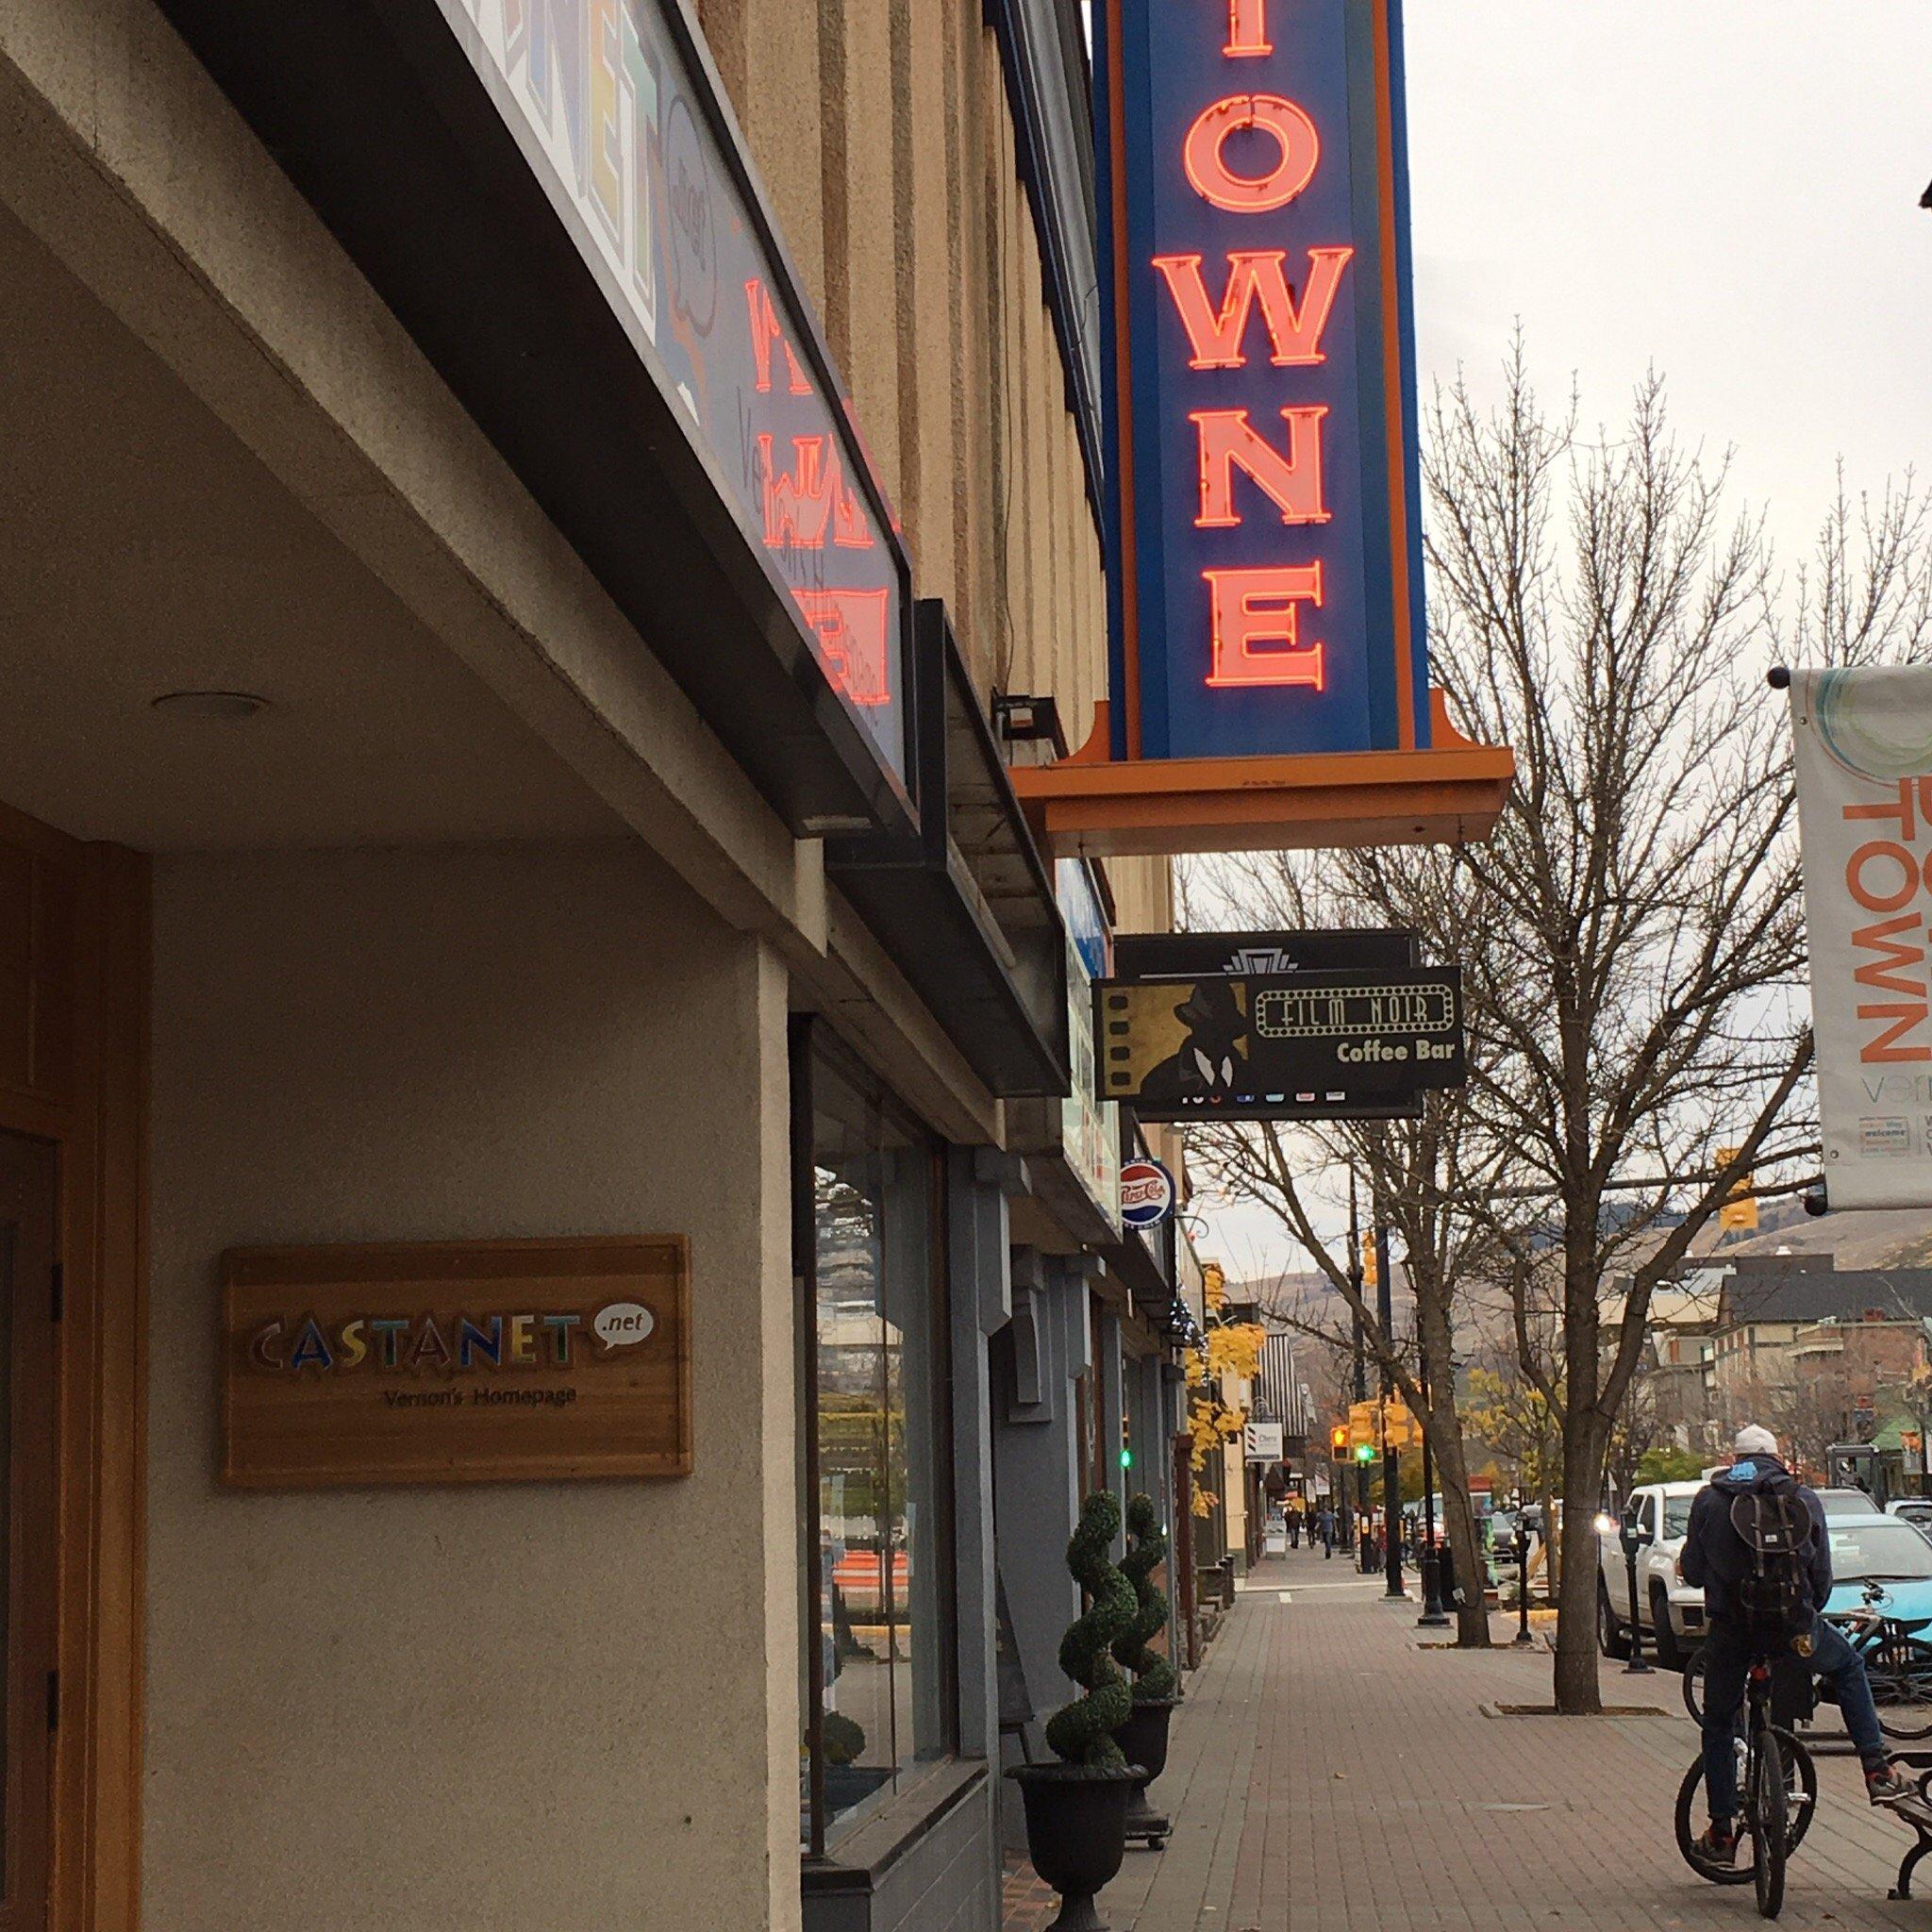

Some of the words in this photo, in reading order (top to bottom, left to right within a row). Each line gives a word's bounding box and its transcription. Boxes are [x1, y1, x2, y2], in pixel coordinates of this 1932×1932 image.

[1842, 776, 1932, 1063] TOWN
[1281, 998, 1346, 1026] FILM
[1371, 995, 1428, 1024] NOIR
[1336, 1040, 1408, 1063] Coffee
[1415, 1041, 1456, 1060] Bar
[251, 1314, 582, 1373] CASTANET
[601, 1311, 644, 1332] .net
[384, 1388, 464, 1407] Vernon's
[472, 1387, 577, 1408] Homepage
